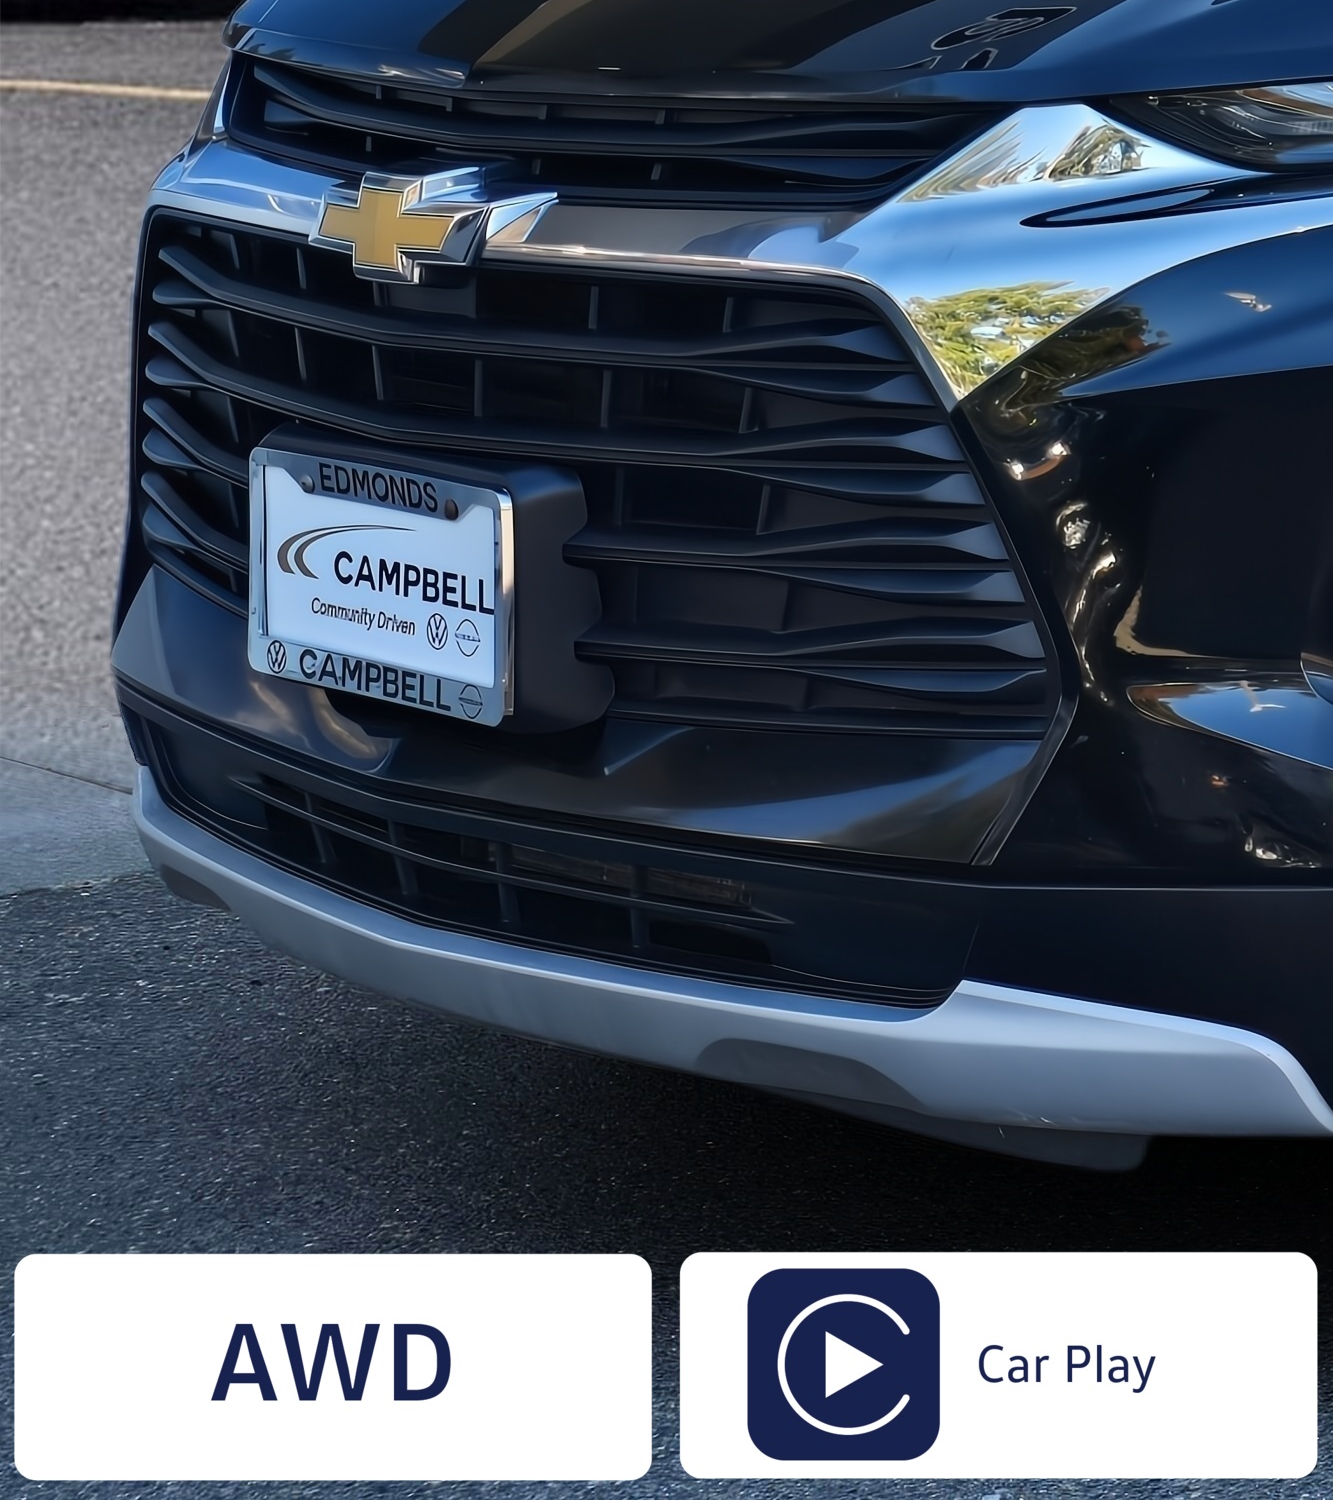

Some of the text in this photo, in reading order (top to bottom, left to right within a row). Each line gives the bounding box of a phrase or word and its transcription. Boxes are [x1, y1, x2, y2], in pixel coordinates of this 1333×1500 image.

[318, 462, 438, 514] EDMONDS
[333, 550, 495, 616] CAMPBELL
[310, 596, 416, 636] Community Driven
[299, 648, 452, 712] CAMPBELL
